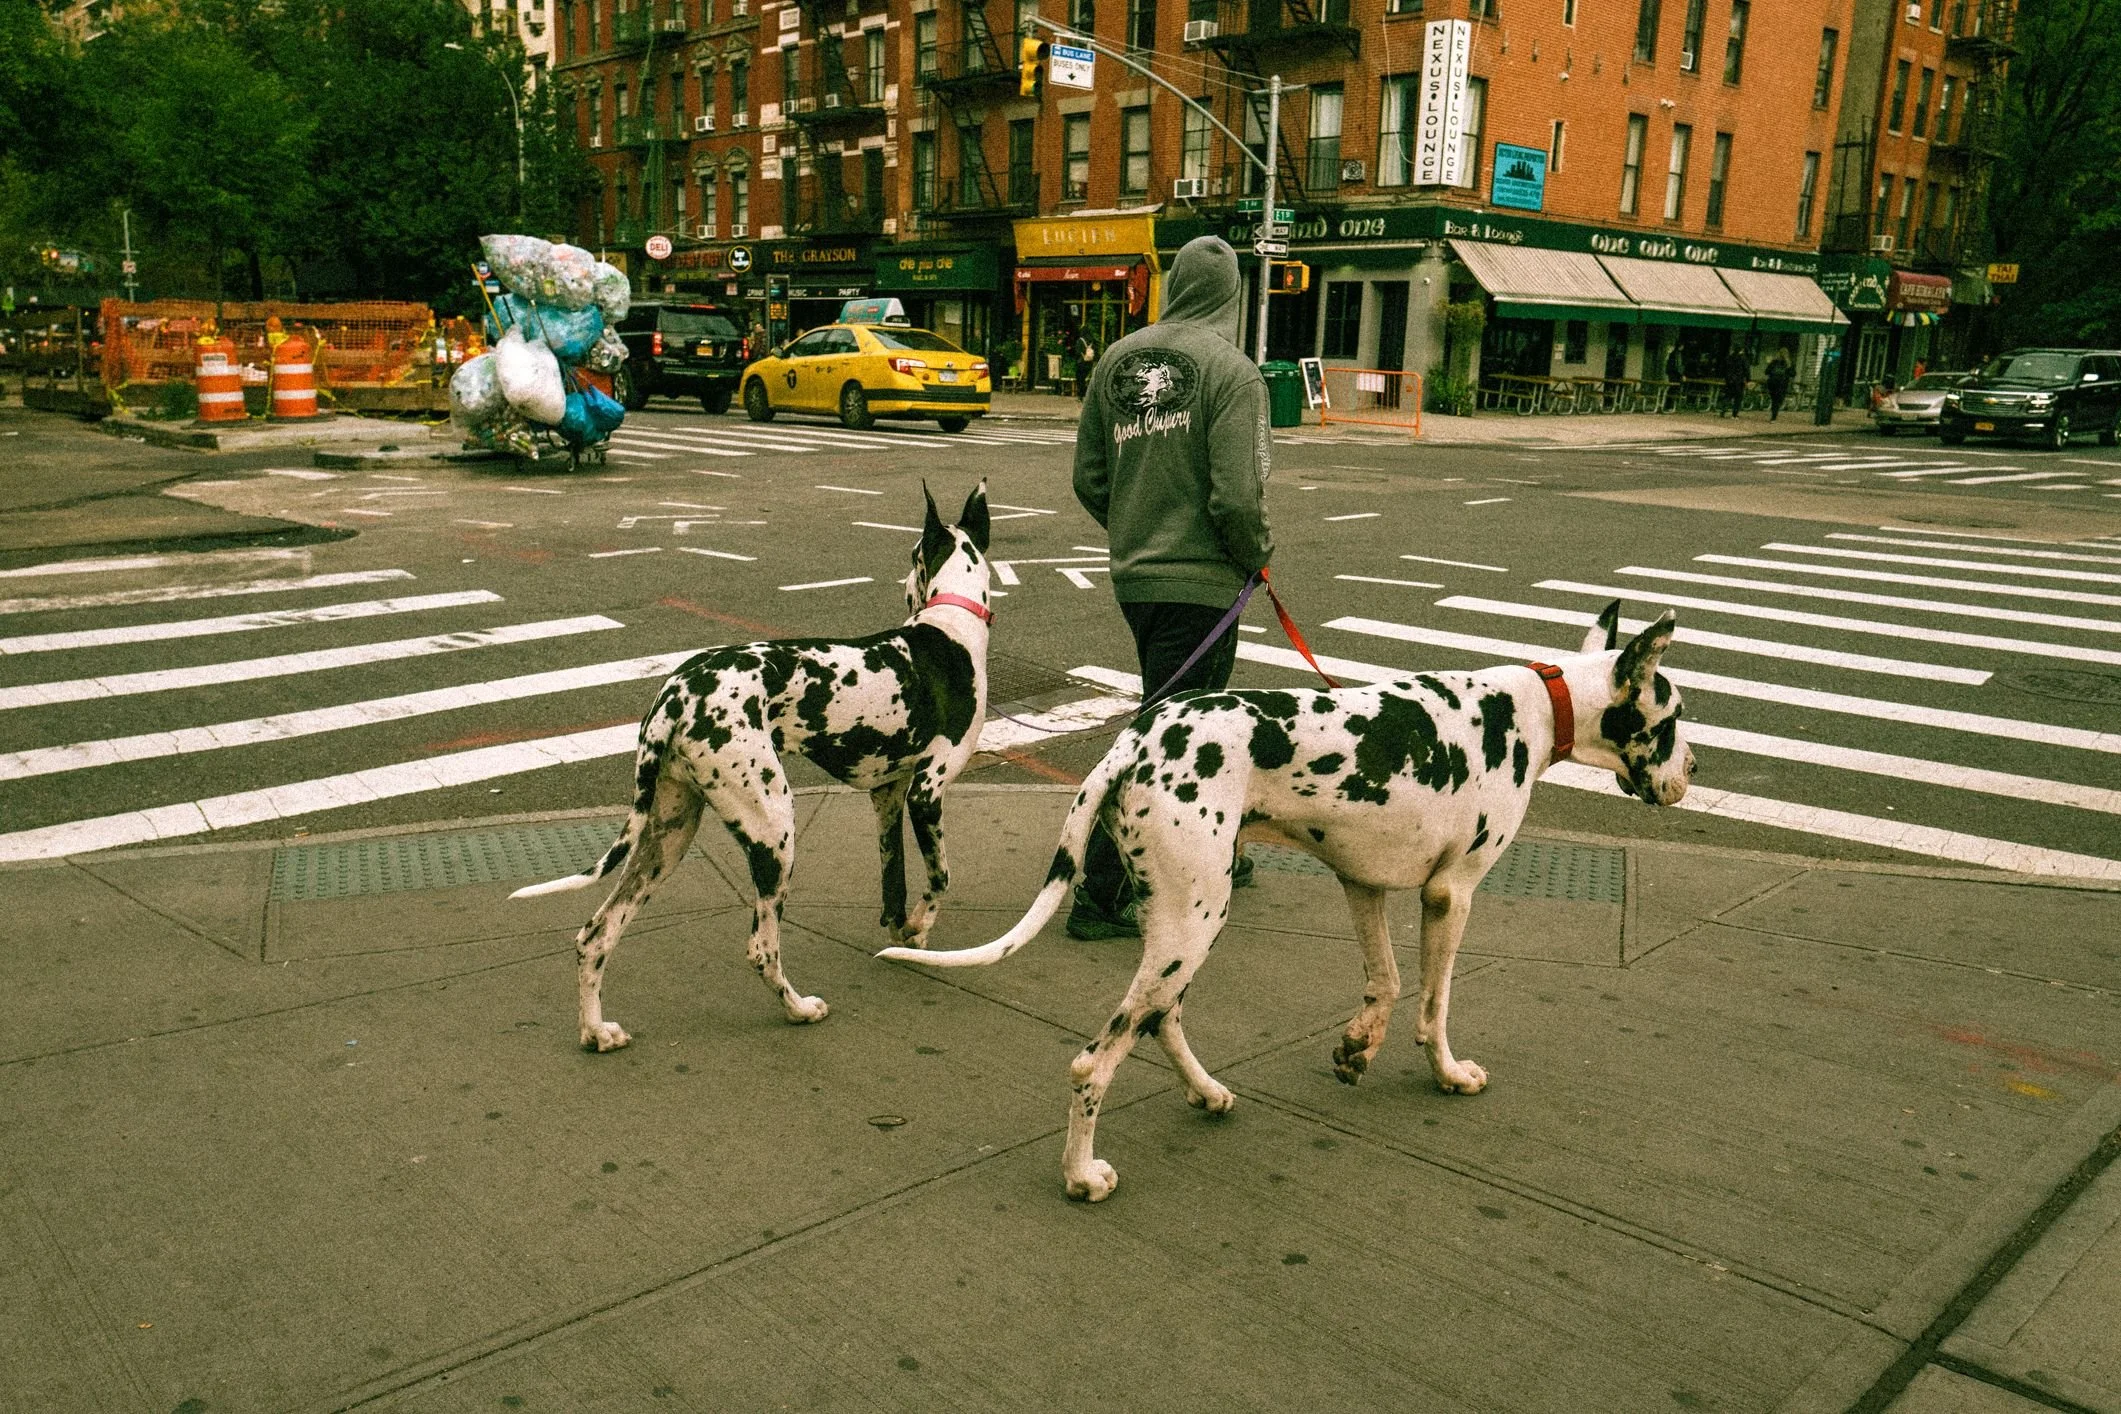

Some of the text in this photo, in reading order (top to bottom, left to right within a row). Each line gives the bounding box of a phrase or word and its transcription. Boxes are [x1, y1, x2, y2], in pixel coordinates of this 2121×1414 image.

[1062, 49, 1092, 60] BUS LANE
[1053, 59, 1091, 72] BUSES ONLY
[1423, 25, 1444, 180] NEXUS LOUNGE
[1446, 25, 1466, 180] NEXUS LOUNGE
[650, 243, 668, 251] DELI
[802, 248, 857, 262] GRAYSON
[838, 288, 860, 296] PARTY
